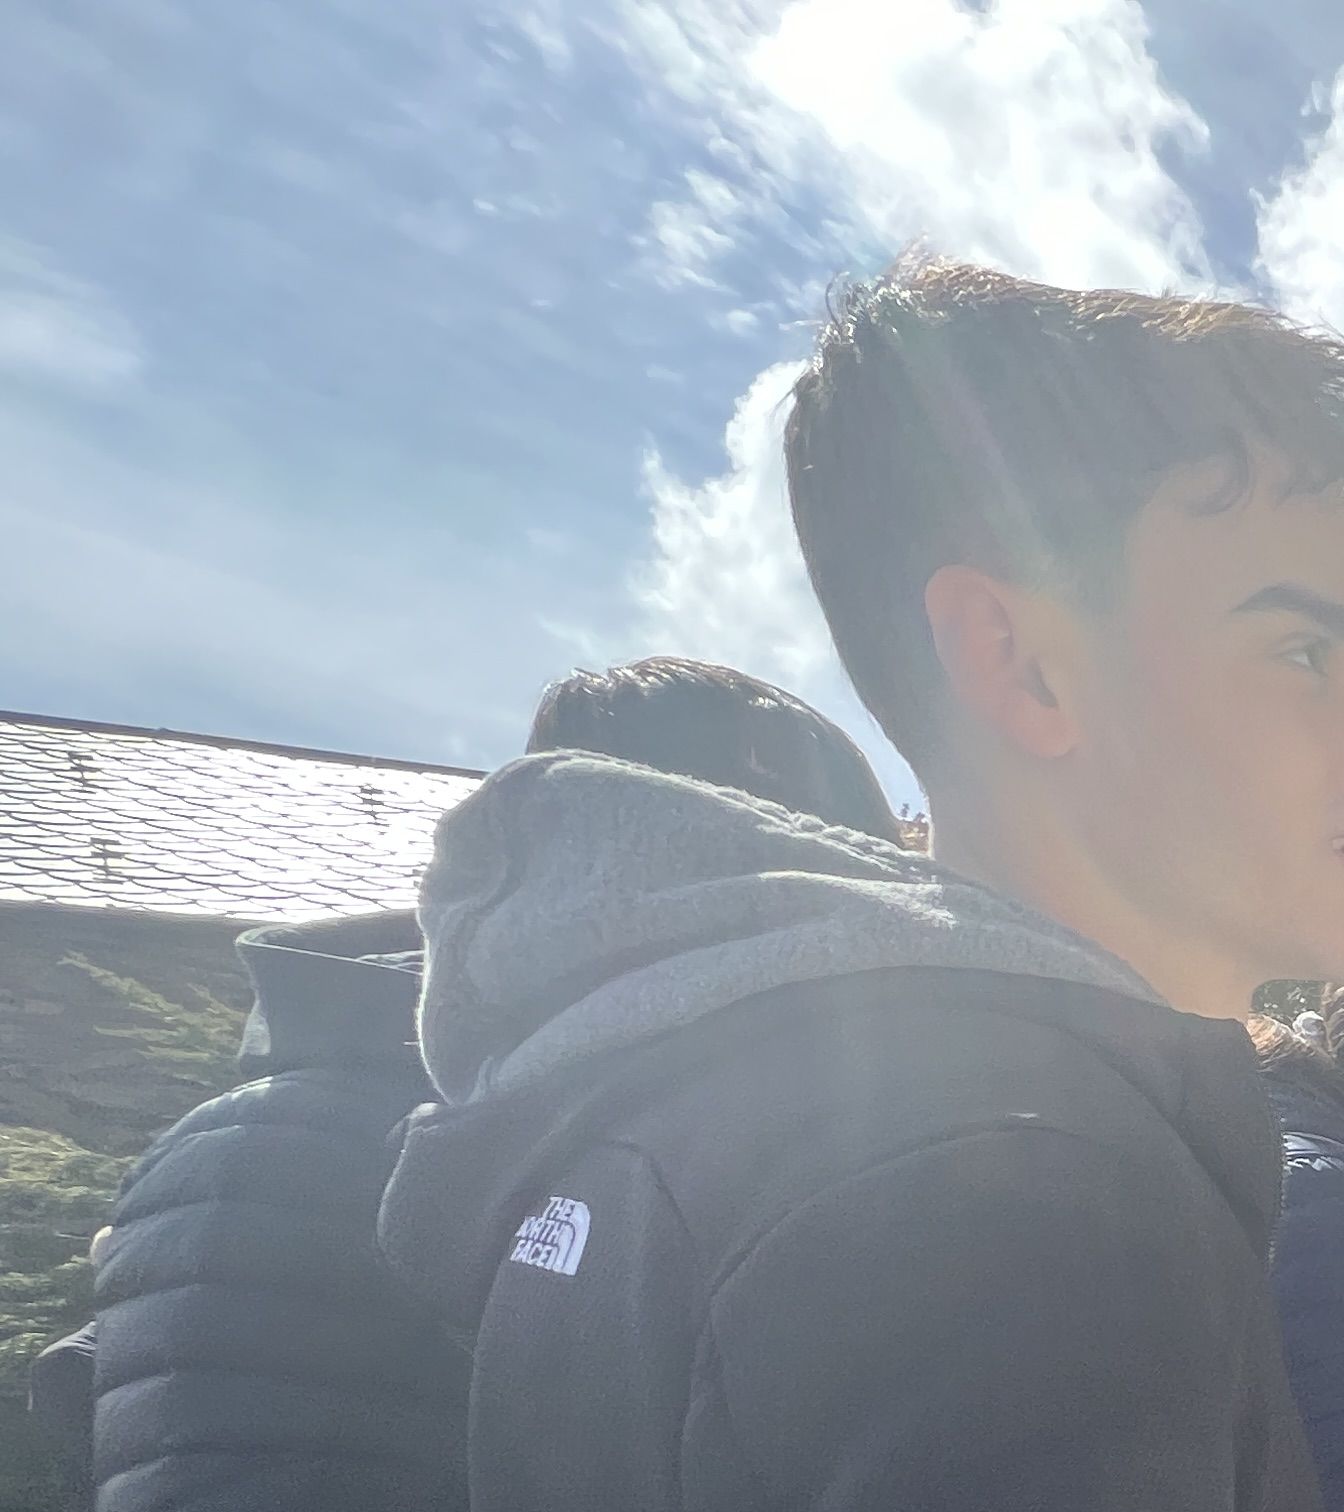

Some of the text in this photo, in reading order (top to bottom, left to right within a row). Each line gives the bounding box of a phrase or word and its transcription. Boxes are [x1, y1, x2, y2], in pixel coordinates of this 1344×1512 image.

[543, 1196, 576, 1220] THE
[514, 1215, 564, 1245] NORTH
[509, 1239, 556, 1270] FACE
